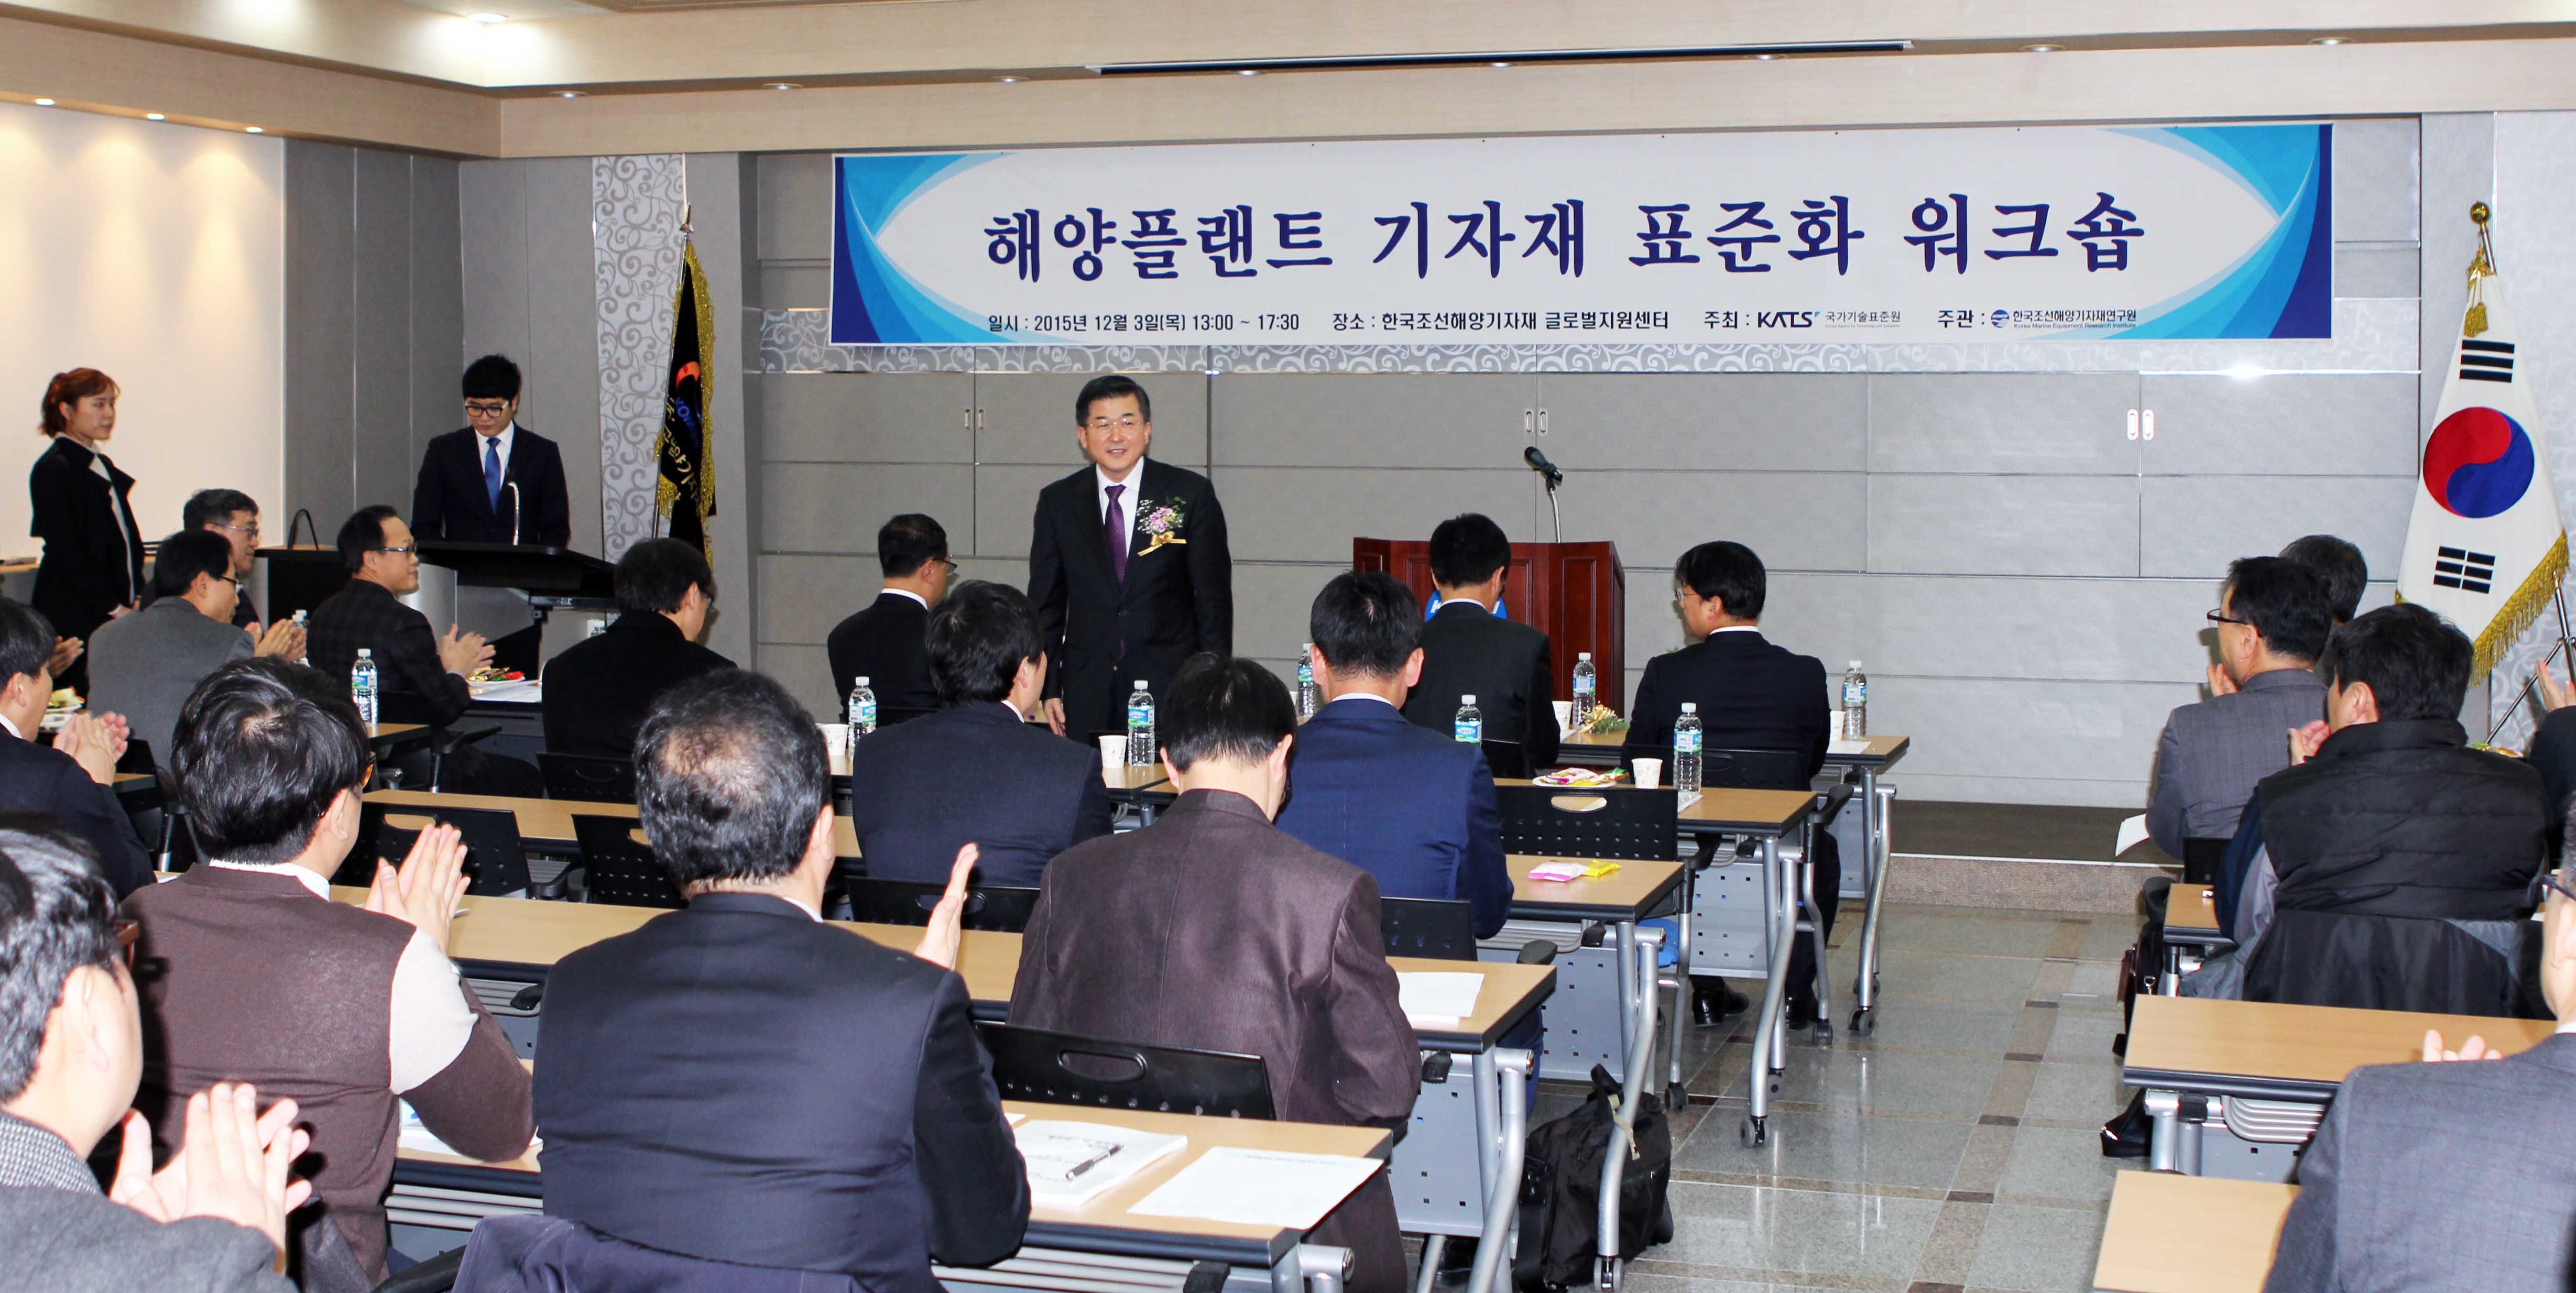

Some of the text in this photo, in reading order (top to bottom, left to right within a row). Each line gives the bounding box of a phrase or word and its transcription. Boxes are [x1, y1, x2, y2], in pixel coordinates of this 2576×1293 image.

[983, 191, 2145, 283] 해양플랜트 기자재 표준화 워크숍
[989, 315, 1018, 332] 일시
[1034, 315, 1086, 332] 2015년
[1095, 314, 1127, 331] 12월
[1134, 314, 1186, 331] 3일(목)
[1193, 314, 1234, 331] 13:00
[1258, 314, 1300, 330] 17:30
[1333, 313, 1365, 331] 장소
[1382, 312, 1537, 330] 한국조선해양기자재
[1545, 311, 1668, 330] 글로벌지원센터
[1704, 311, 1738, 329] 주최
[1757, 311, 1813, 328] KATS
[1825, 310, 1901, 323] 국가기술표준원
[1937, 310, 1974, 328] 주관
[2013, 310, 2137, 322] 한국조선해양기자재연구원
